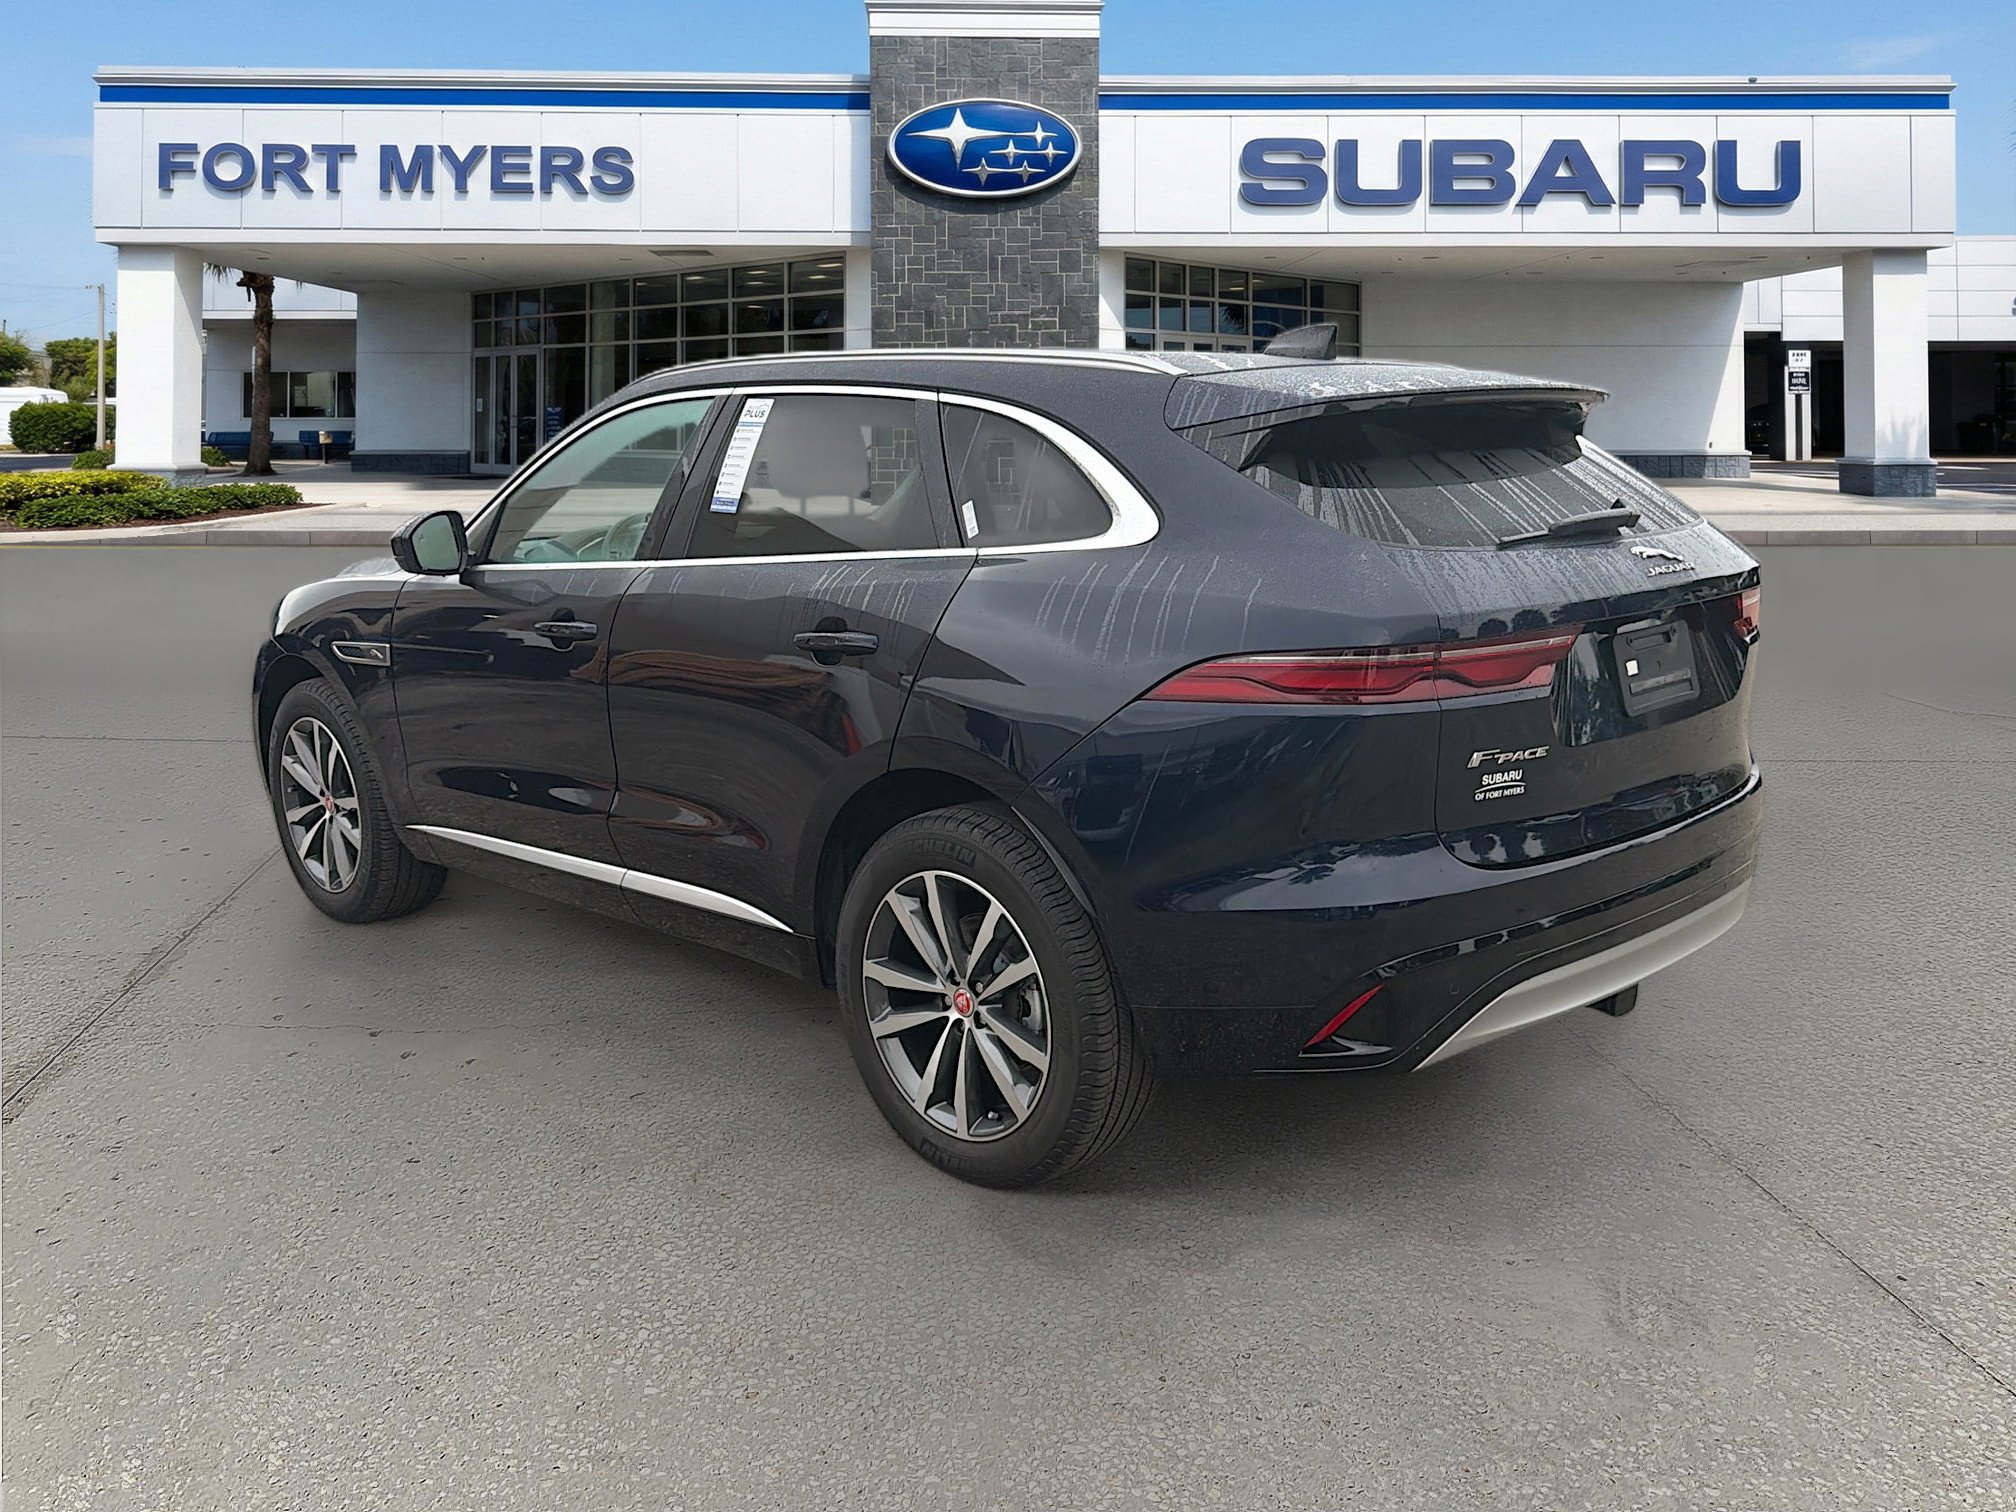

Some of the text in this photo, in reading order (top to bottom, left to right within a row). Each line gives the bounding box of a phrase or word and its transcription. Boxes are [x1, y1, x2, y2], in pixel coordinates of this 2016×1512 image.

[158, 142, 634, 194] FORT MYERS
[1240, 137, 1801, 206] SUBARU
[744, 409, 766, 418] PLUS
[1647, 561, 1694, 577] JAGUAR
[1481, 769, 1523, 785] SUBARU
[1474, 785, 1525, 801] OF FORT MYERS
